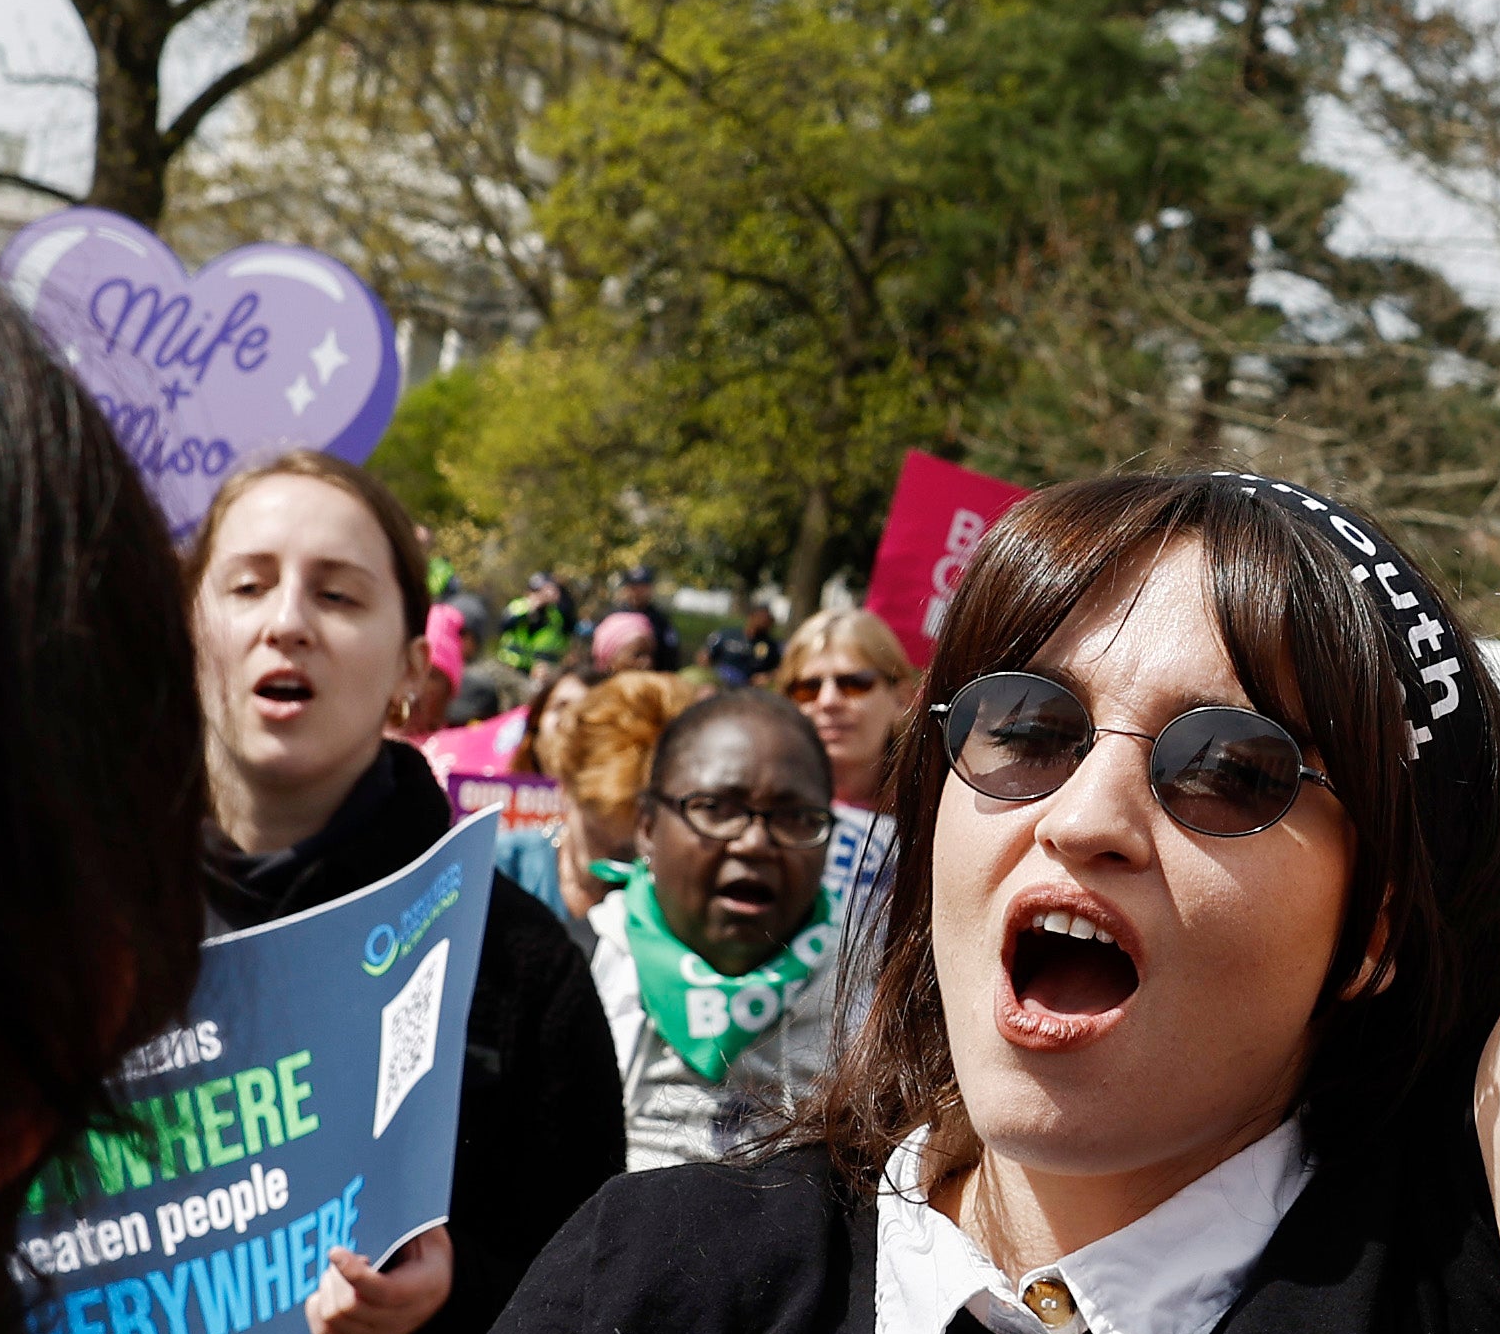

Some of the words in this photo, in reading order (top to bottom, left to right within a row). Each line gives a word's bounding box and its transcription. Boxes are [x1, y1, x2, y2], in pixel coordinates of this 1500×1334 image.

[90, 278, 269, 383] Mife
[26, 1050, 320, 1215] WHERE
[7, 1211, 152, 1284] eaten
[156, 1163, 289, 1256] people
